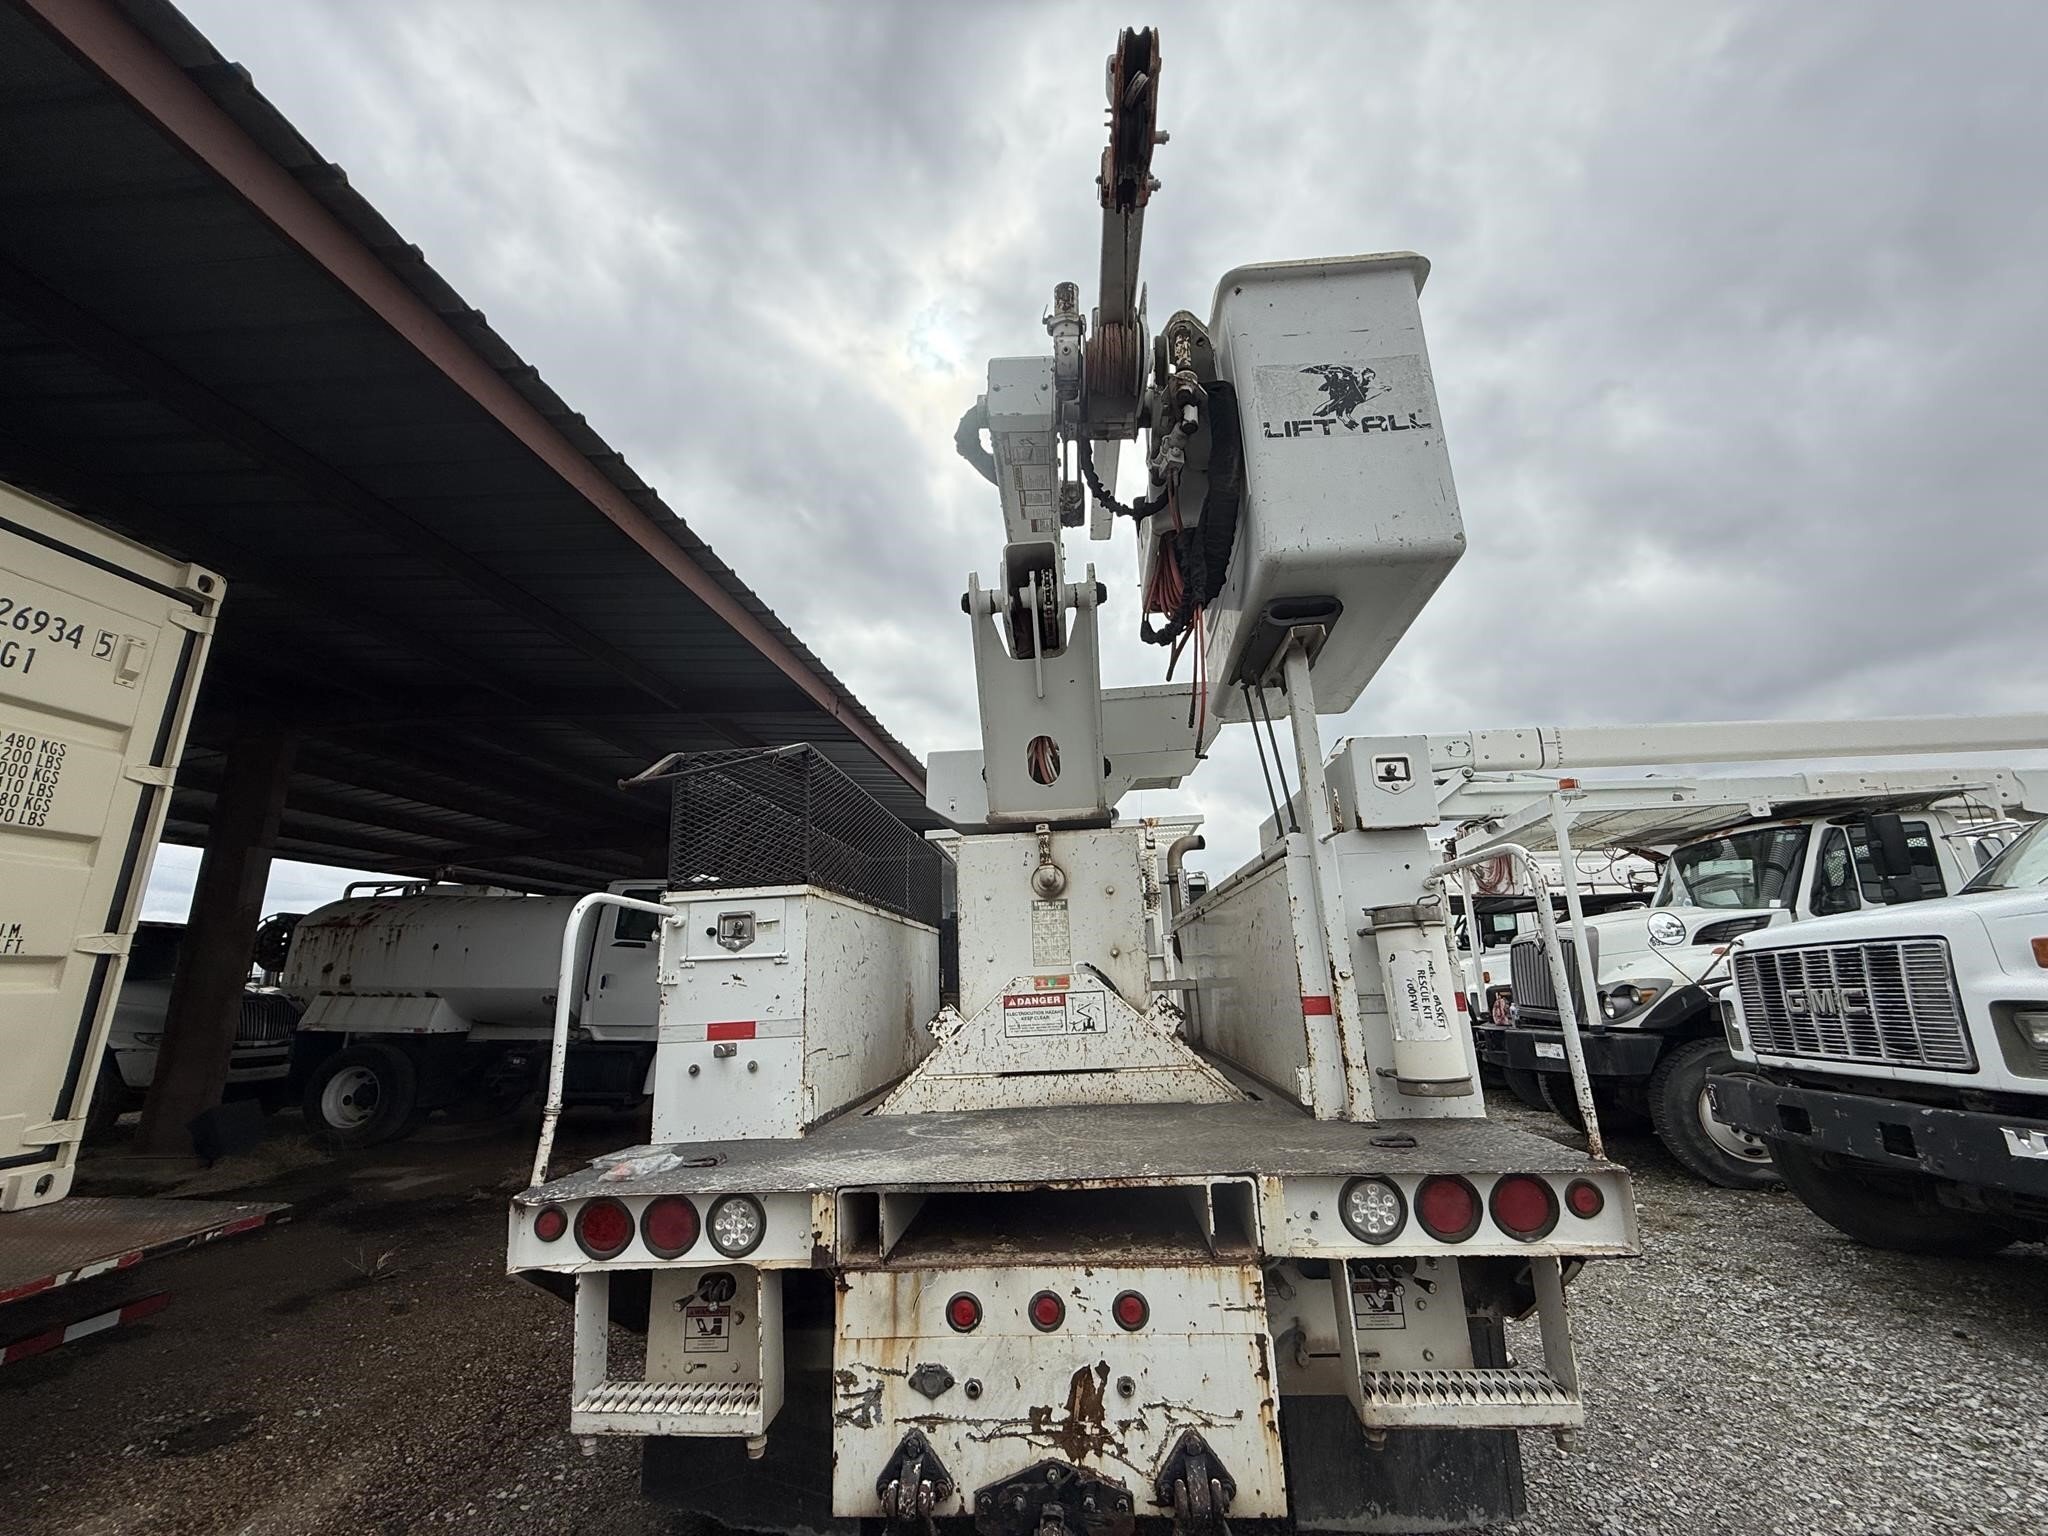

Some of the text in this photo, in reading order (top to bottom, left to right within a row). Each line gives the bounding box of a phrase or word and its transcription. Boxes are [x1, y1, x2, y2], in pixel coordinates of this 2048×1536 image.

[1263, 418, 1337, 438] LIFT
[0, 598, 113, 657] 26934 5
[0, 641, 37, 674] G1
[40, 739, 67, 757] KGS
[36, 753, 63, 771] LBS
[33, 767, 60, 785] KGS
[28, 781, 55, 799] LBS
[23, 796, 52, 813] KGS
[18, 810, 47, 827] LBS
[1017, 996, 1061, 1006] DANGER
[1417, 969, 1433, 1020] RESCUE KIT
[1785, 987, 1869, 1015] GMC
